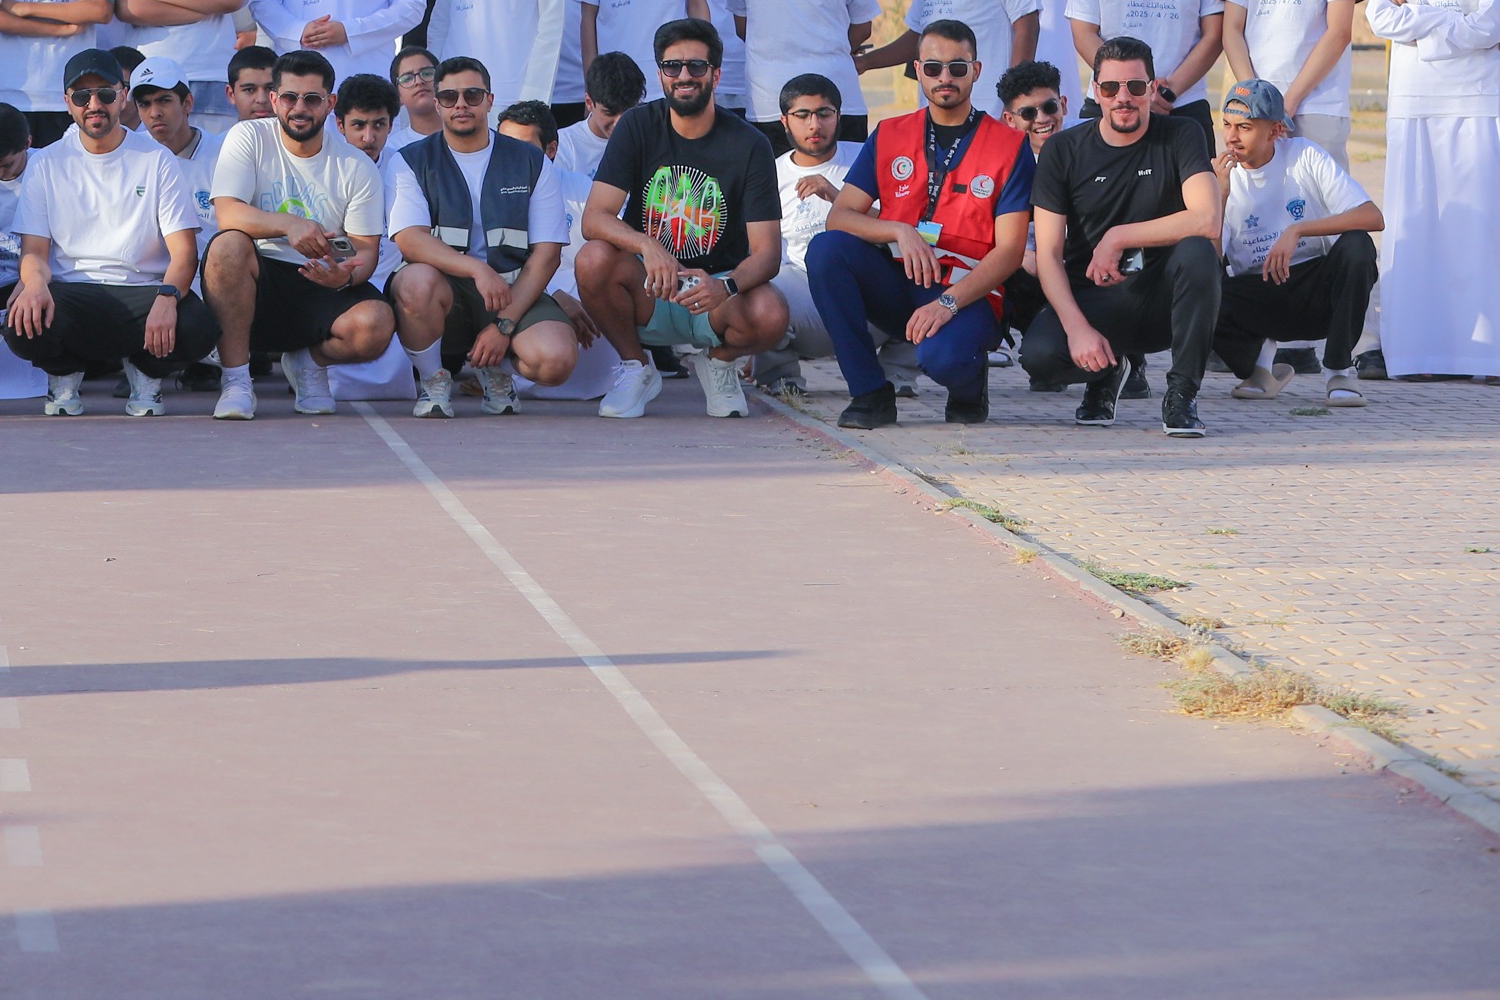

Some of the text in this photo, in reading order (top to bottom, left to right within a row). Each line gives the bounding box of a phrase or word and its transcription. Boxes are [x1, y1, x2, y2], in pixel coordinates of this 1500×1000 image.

[1125, 10, 1149, 19] 2025م
[1169, 12, 1180, 20] 26
[1297, 240, 1306, 248] 26
[1252, 245, 1270, 254] عطاء
